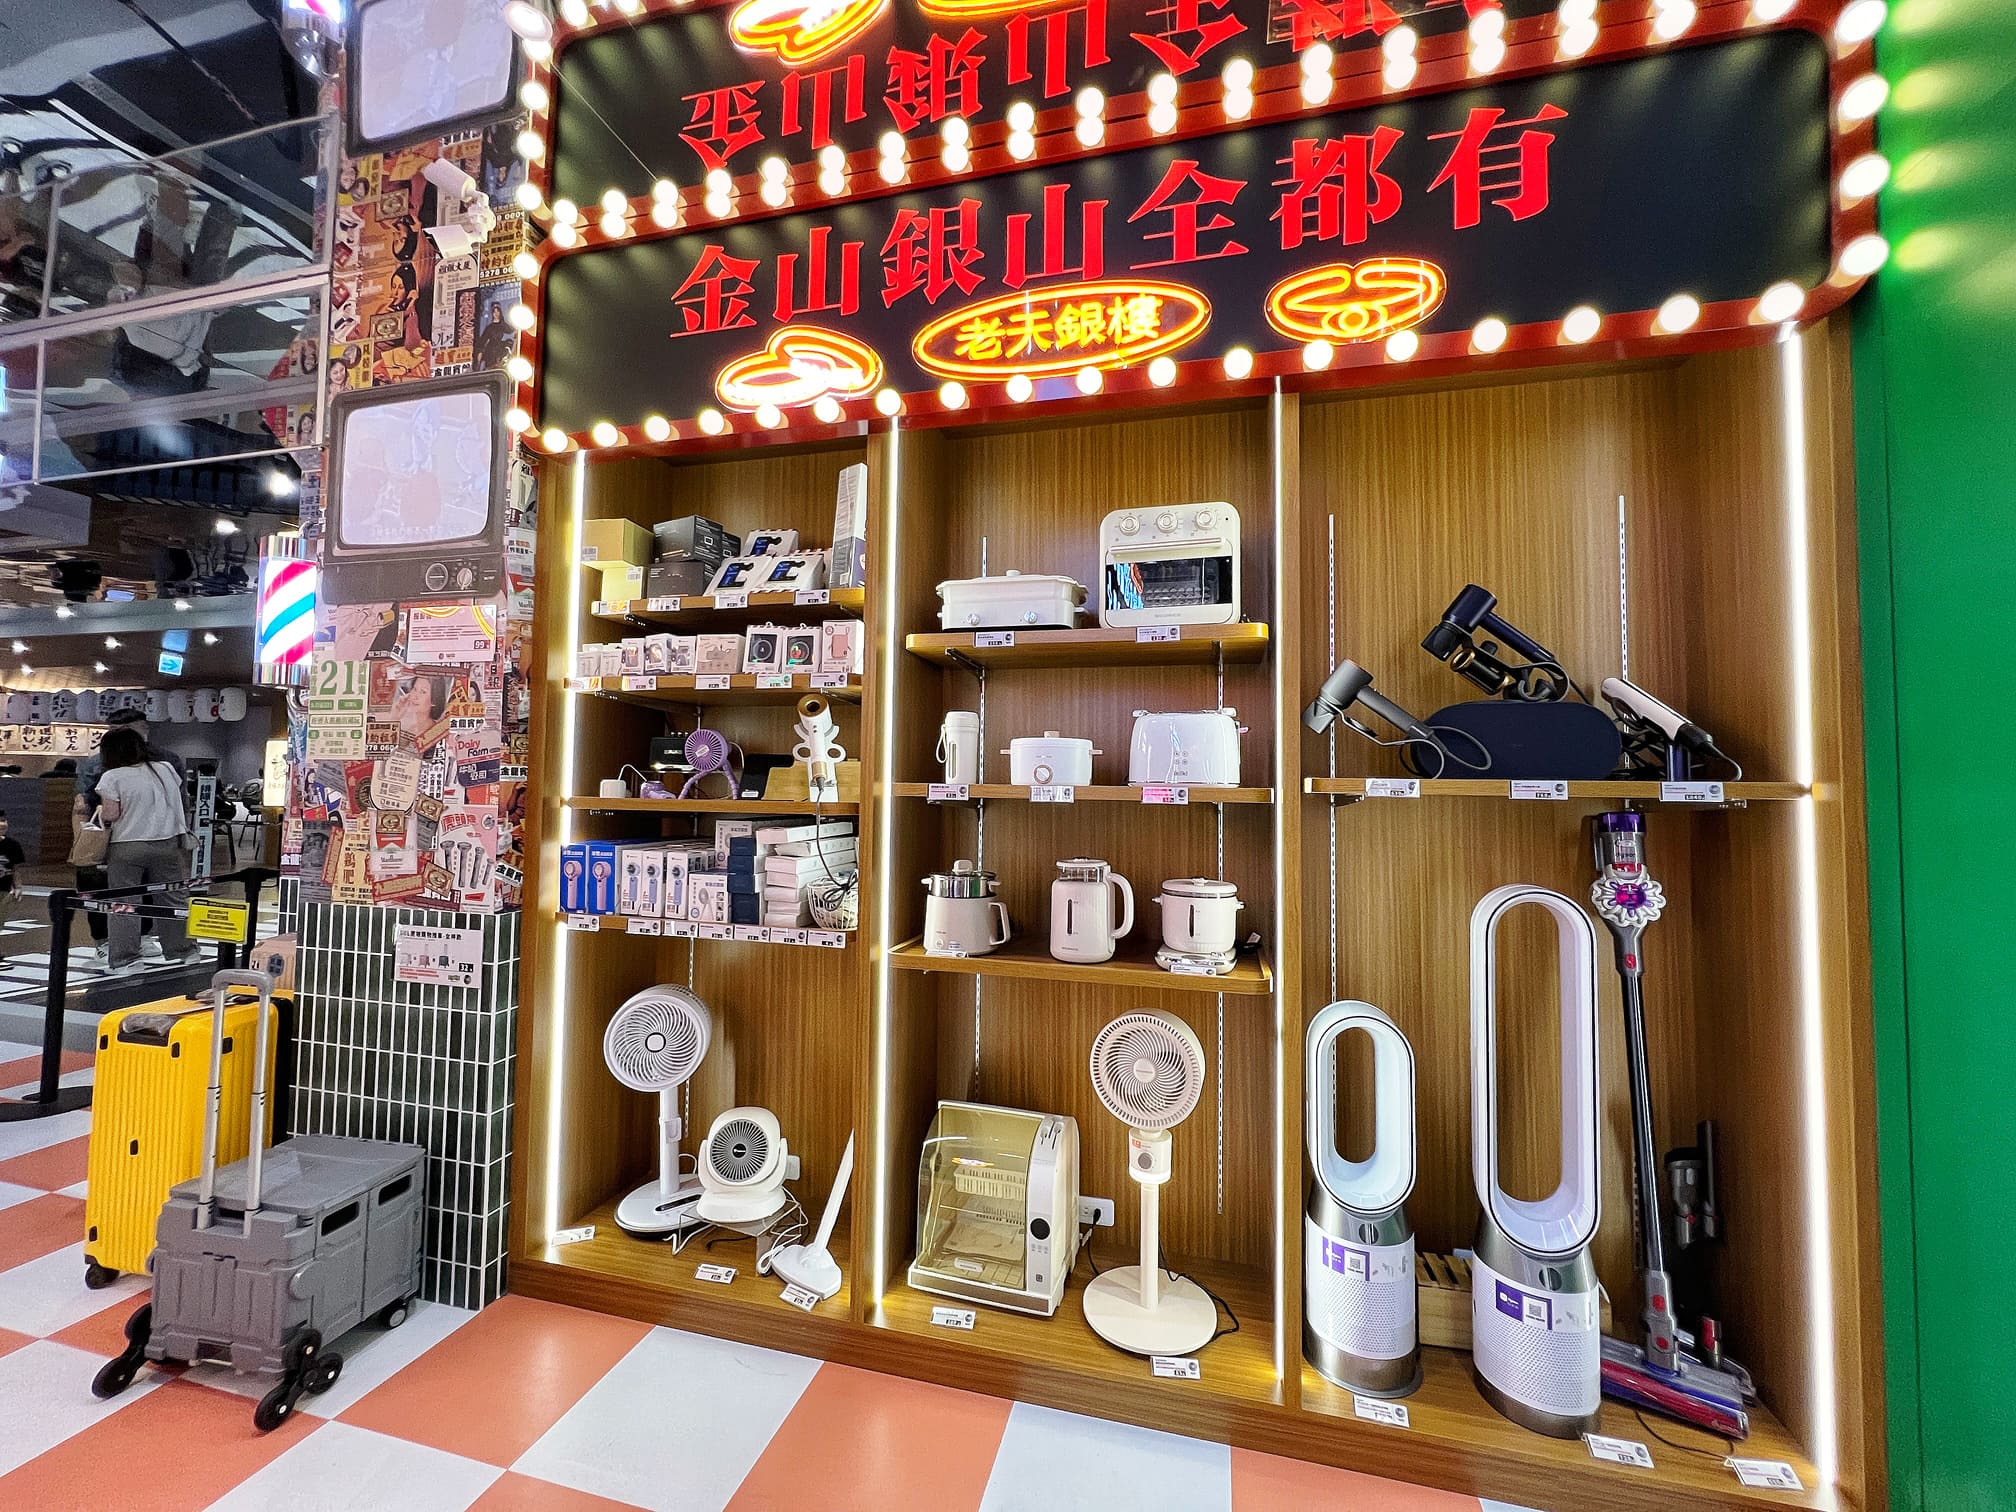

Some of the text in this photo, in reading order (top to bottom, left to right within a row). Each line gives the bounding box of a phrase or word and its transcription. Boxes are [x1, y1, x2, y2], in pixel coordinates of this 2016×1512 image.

[670, 103, 1568, 338] 金山銀山全都有
[320, 660, 354, 695] 21
[458, 739, 480, 750] Dairy
